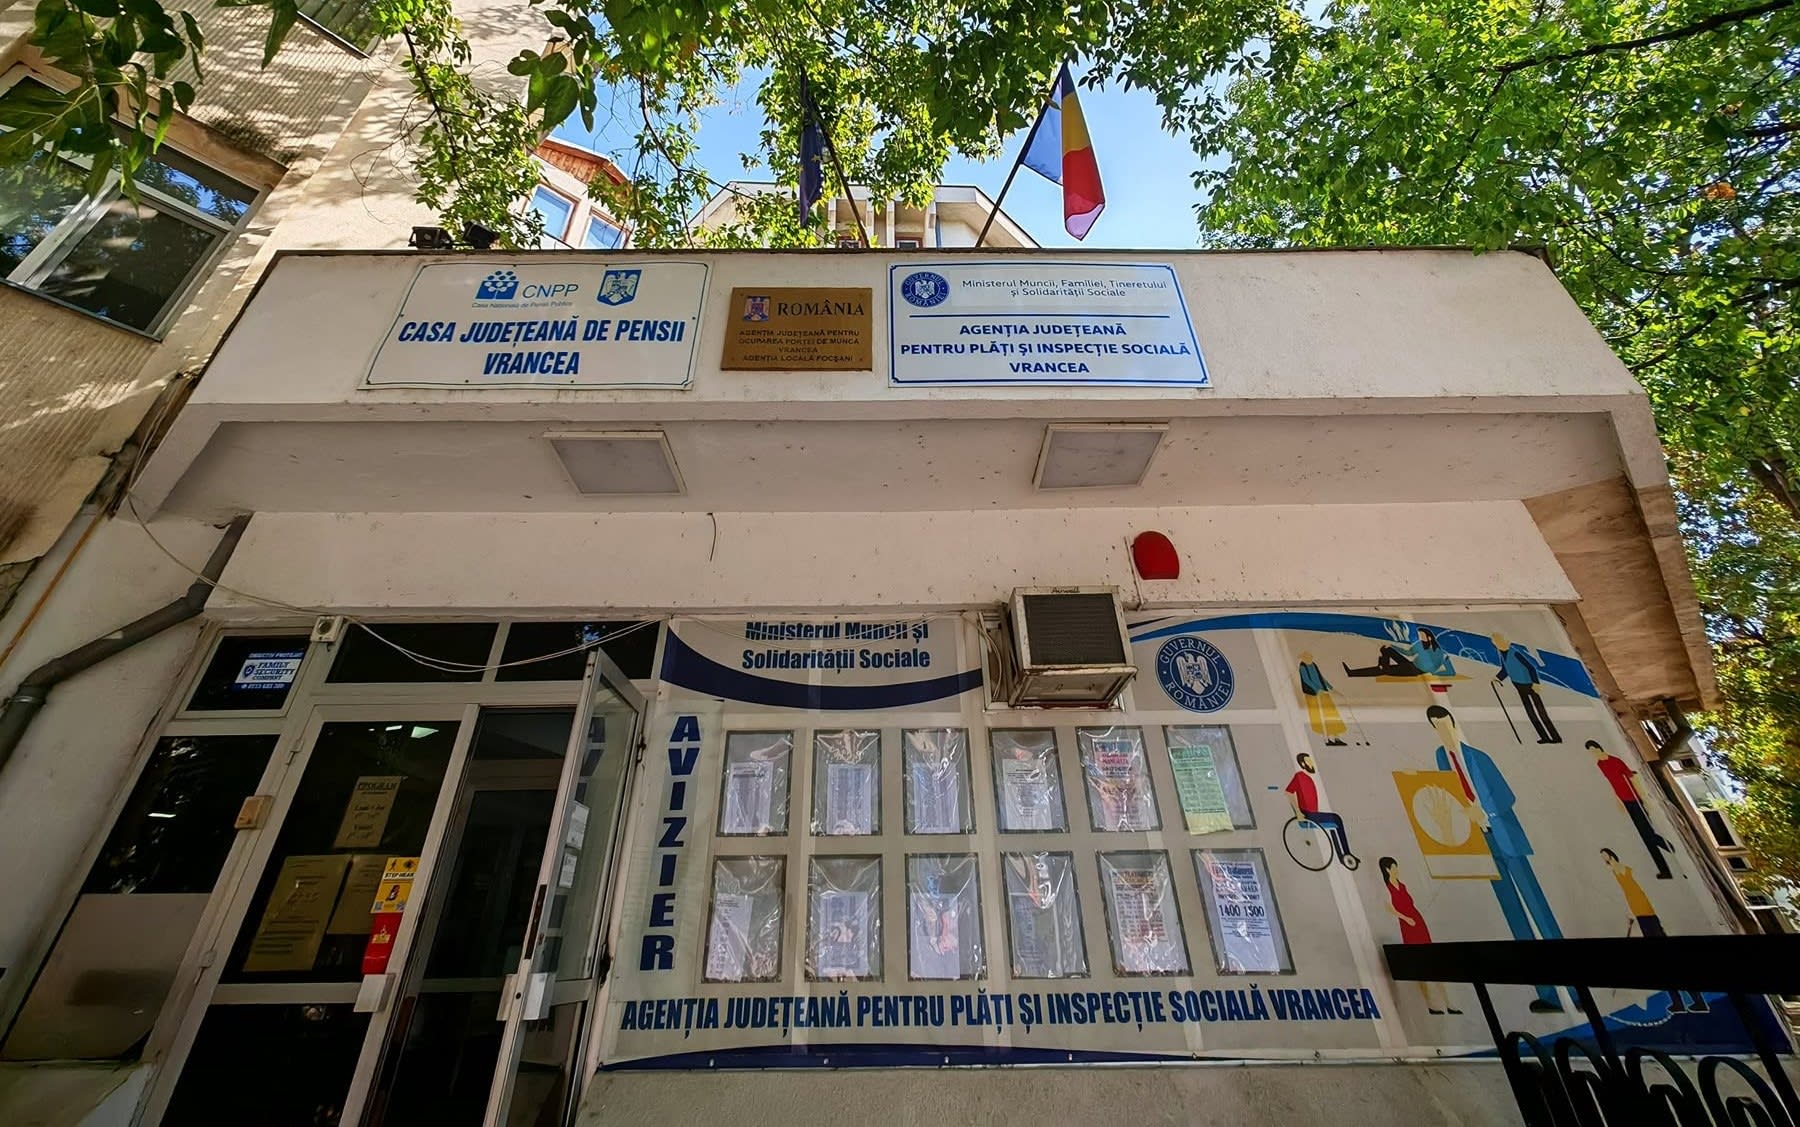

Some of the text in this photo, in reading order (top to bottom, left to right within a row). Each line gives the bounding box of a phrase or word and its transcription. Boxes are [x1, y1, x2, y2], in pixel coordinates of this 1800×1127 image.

[522, 284, 579, 298] CNPP
[1020, 280, 1058, 288] Muncii,
[1061, 279, 1107, 288] Familiei,
[1109, 280, 1167, 288] Tineretului
[1087, 288, 1126, 296] Sociale
[778, 300, 864, 316] ROMÂNIA
[398, 315, 686, 347] CASA JUDEȚEANĂ DE PENSII
[960, 325, 1030, 338] AGENȚIA
[901, 344, 965, 354] PENTRU
[970, 340, 1014, 356] PLĂȚI
[1037, 343, 1119, 357] INSPECȚIE
[1121, 342, 1191, 355] SOCIALĂ
[483, 352, 580, 375] VRANCEA
[1009, 362, 1090, 373] VRANCEA
[745, 621, 840, 640] Ministerul
[845, 621, 908, 640] Muncii
[859, 648, 931, 668] Sociale
[1160, 638, 1221, 664] GUVERNUL
[254, 668, 297, 676] SECURITY
[257, 661, 290, 669] FAMILY
[639, 715, 702, 972] AVIZIER
[1219, 904, 1265, 917] 1400 1500
[621, 998, 719, 1039] AGENȚIA
[723, 990, 851, 1037] JUDEȚEANĂ
[857, 995, 945, 1027] PENTRU
[951, 988, 1013, 1034] PLĂȚI
[1050, 990, 1167, 1032] INSPECȚIE
[1171, 983, 1270, 1022] SOCIALĂ
[1268, 988, 1382, 1021] VRANCEA
